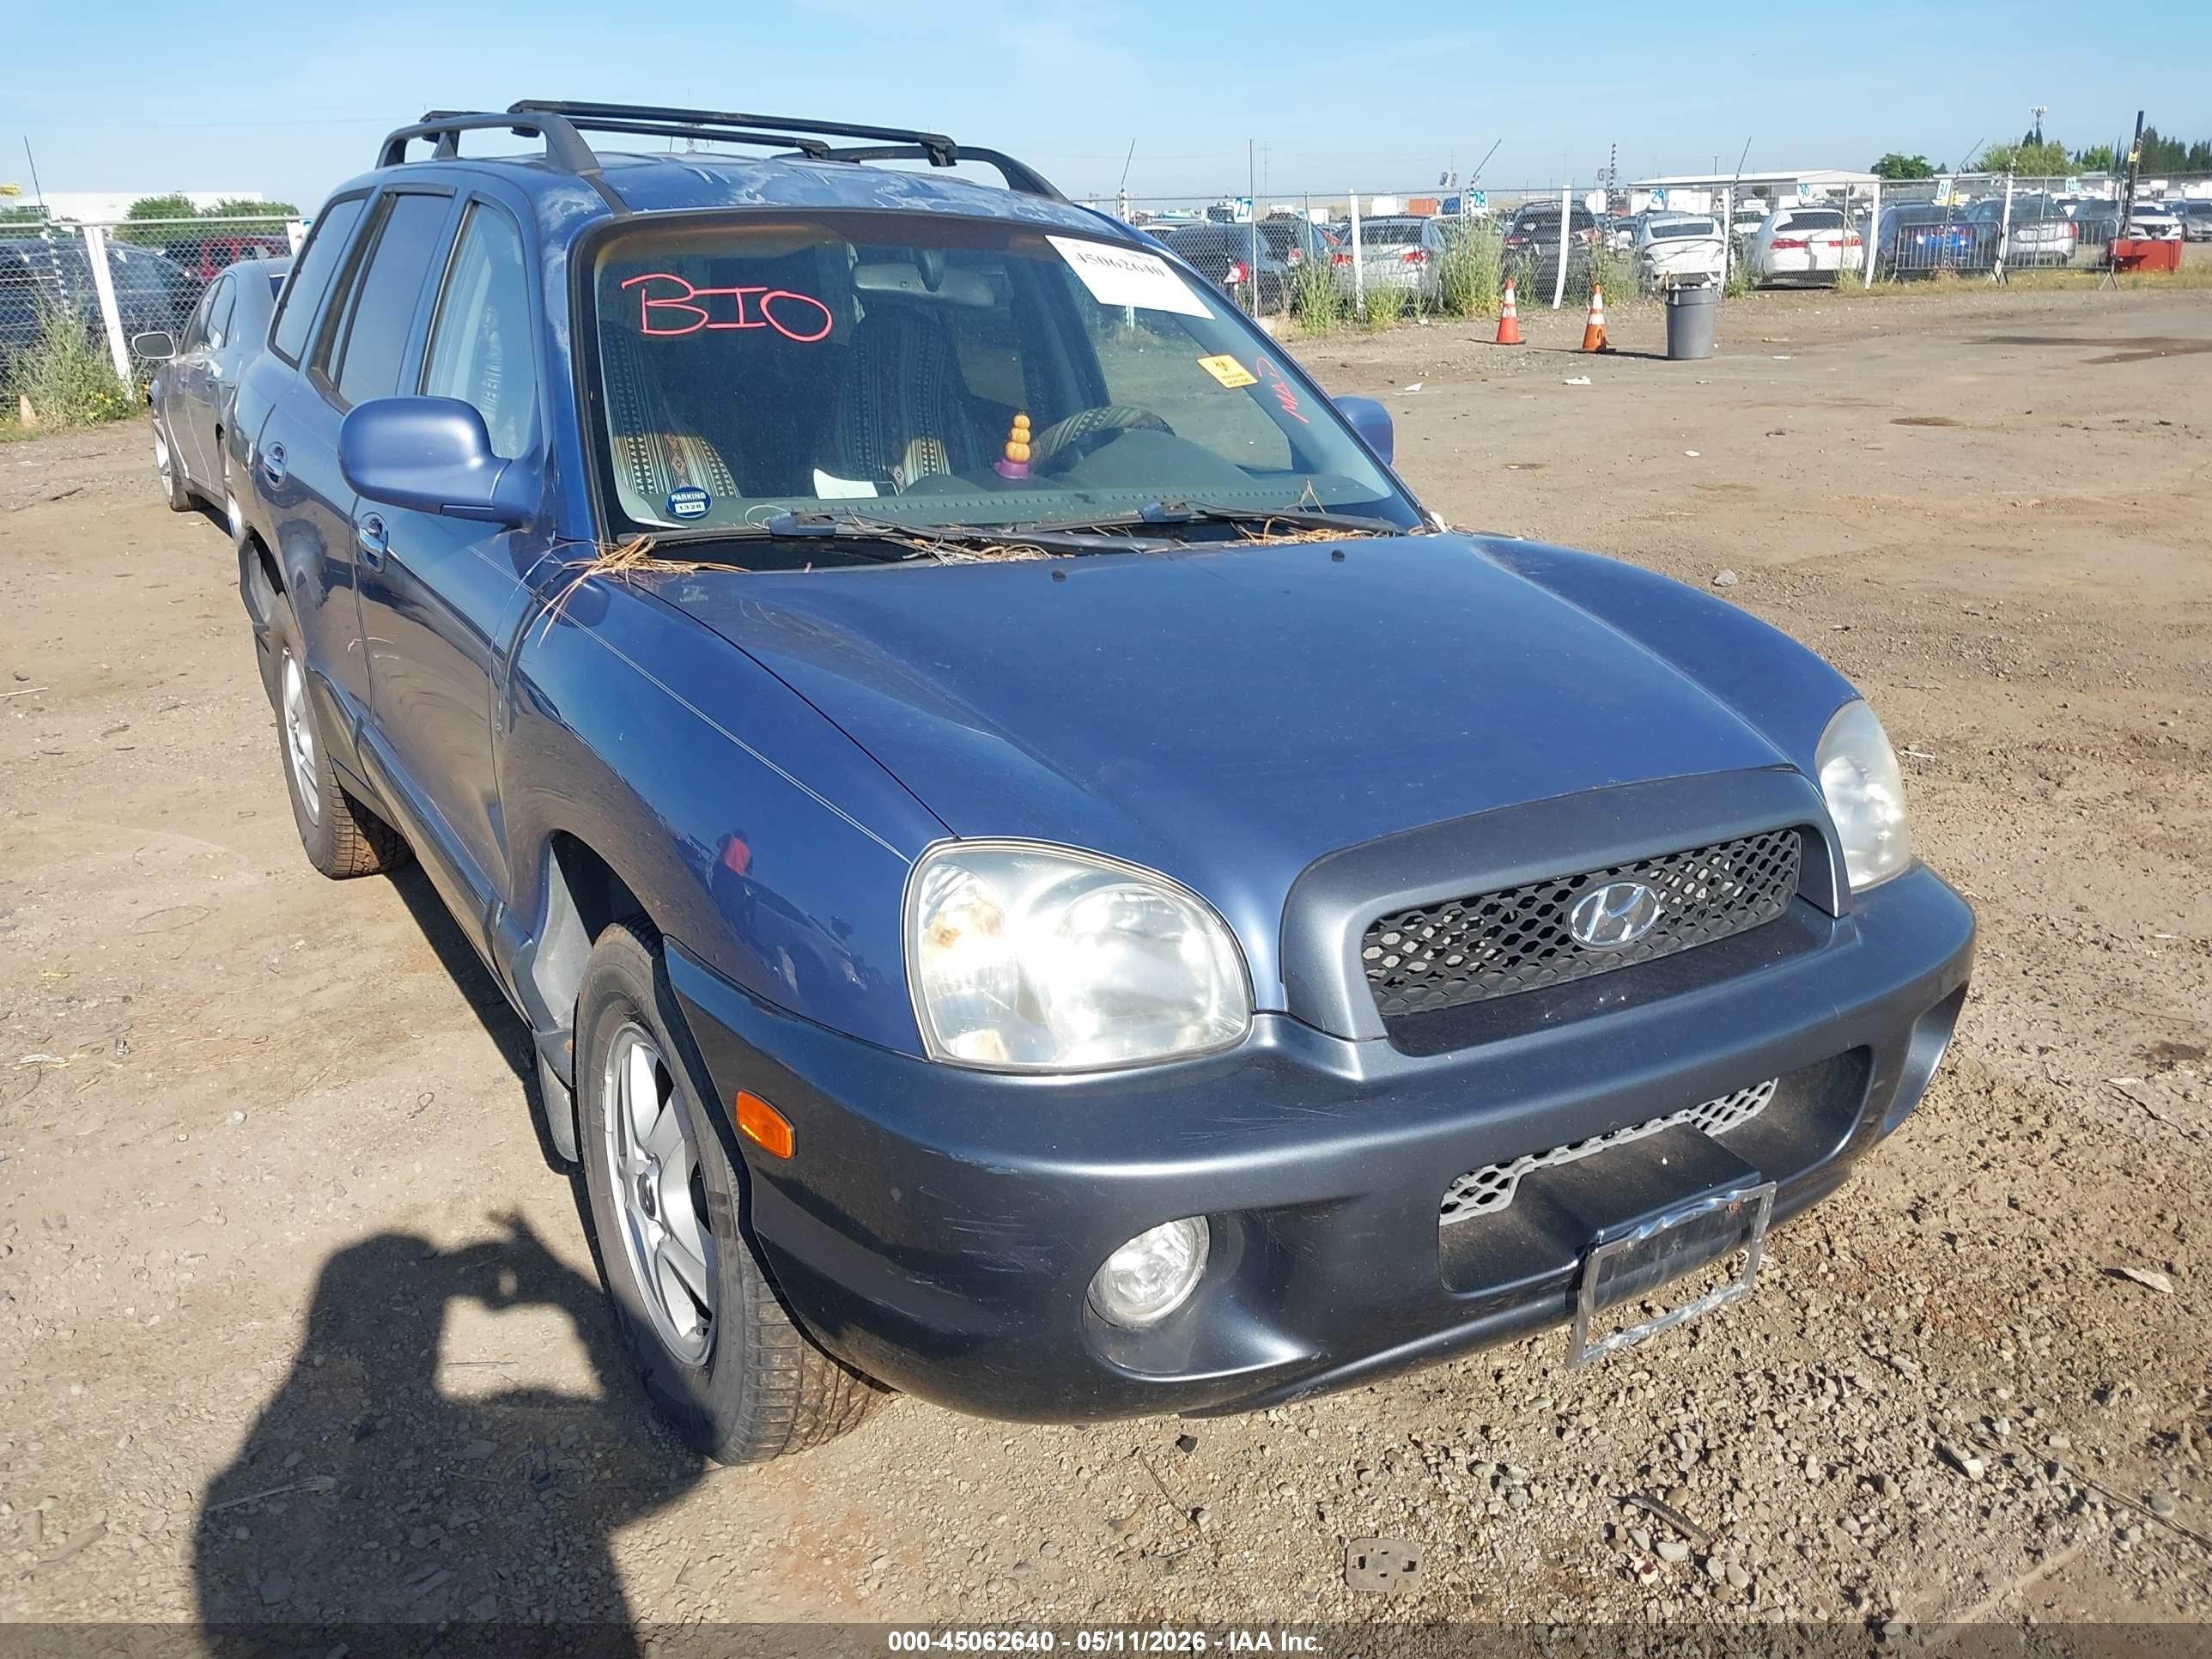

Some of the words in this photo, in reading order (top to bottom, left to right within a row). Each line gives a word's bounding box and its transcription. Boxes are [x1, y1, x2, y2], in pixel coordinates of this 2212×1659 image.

[1469, 190, 1486, 208] 28
[1650, 187, 1664, 206] 29
[1235, 197, 1253, 218] 27
[621, 273, 833, 342] BIO
[671, 491, 707, 502] PARKING
